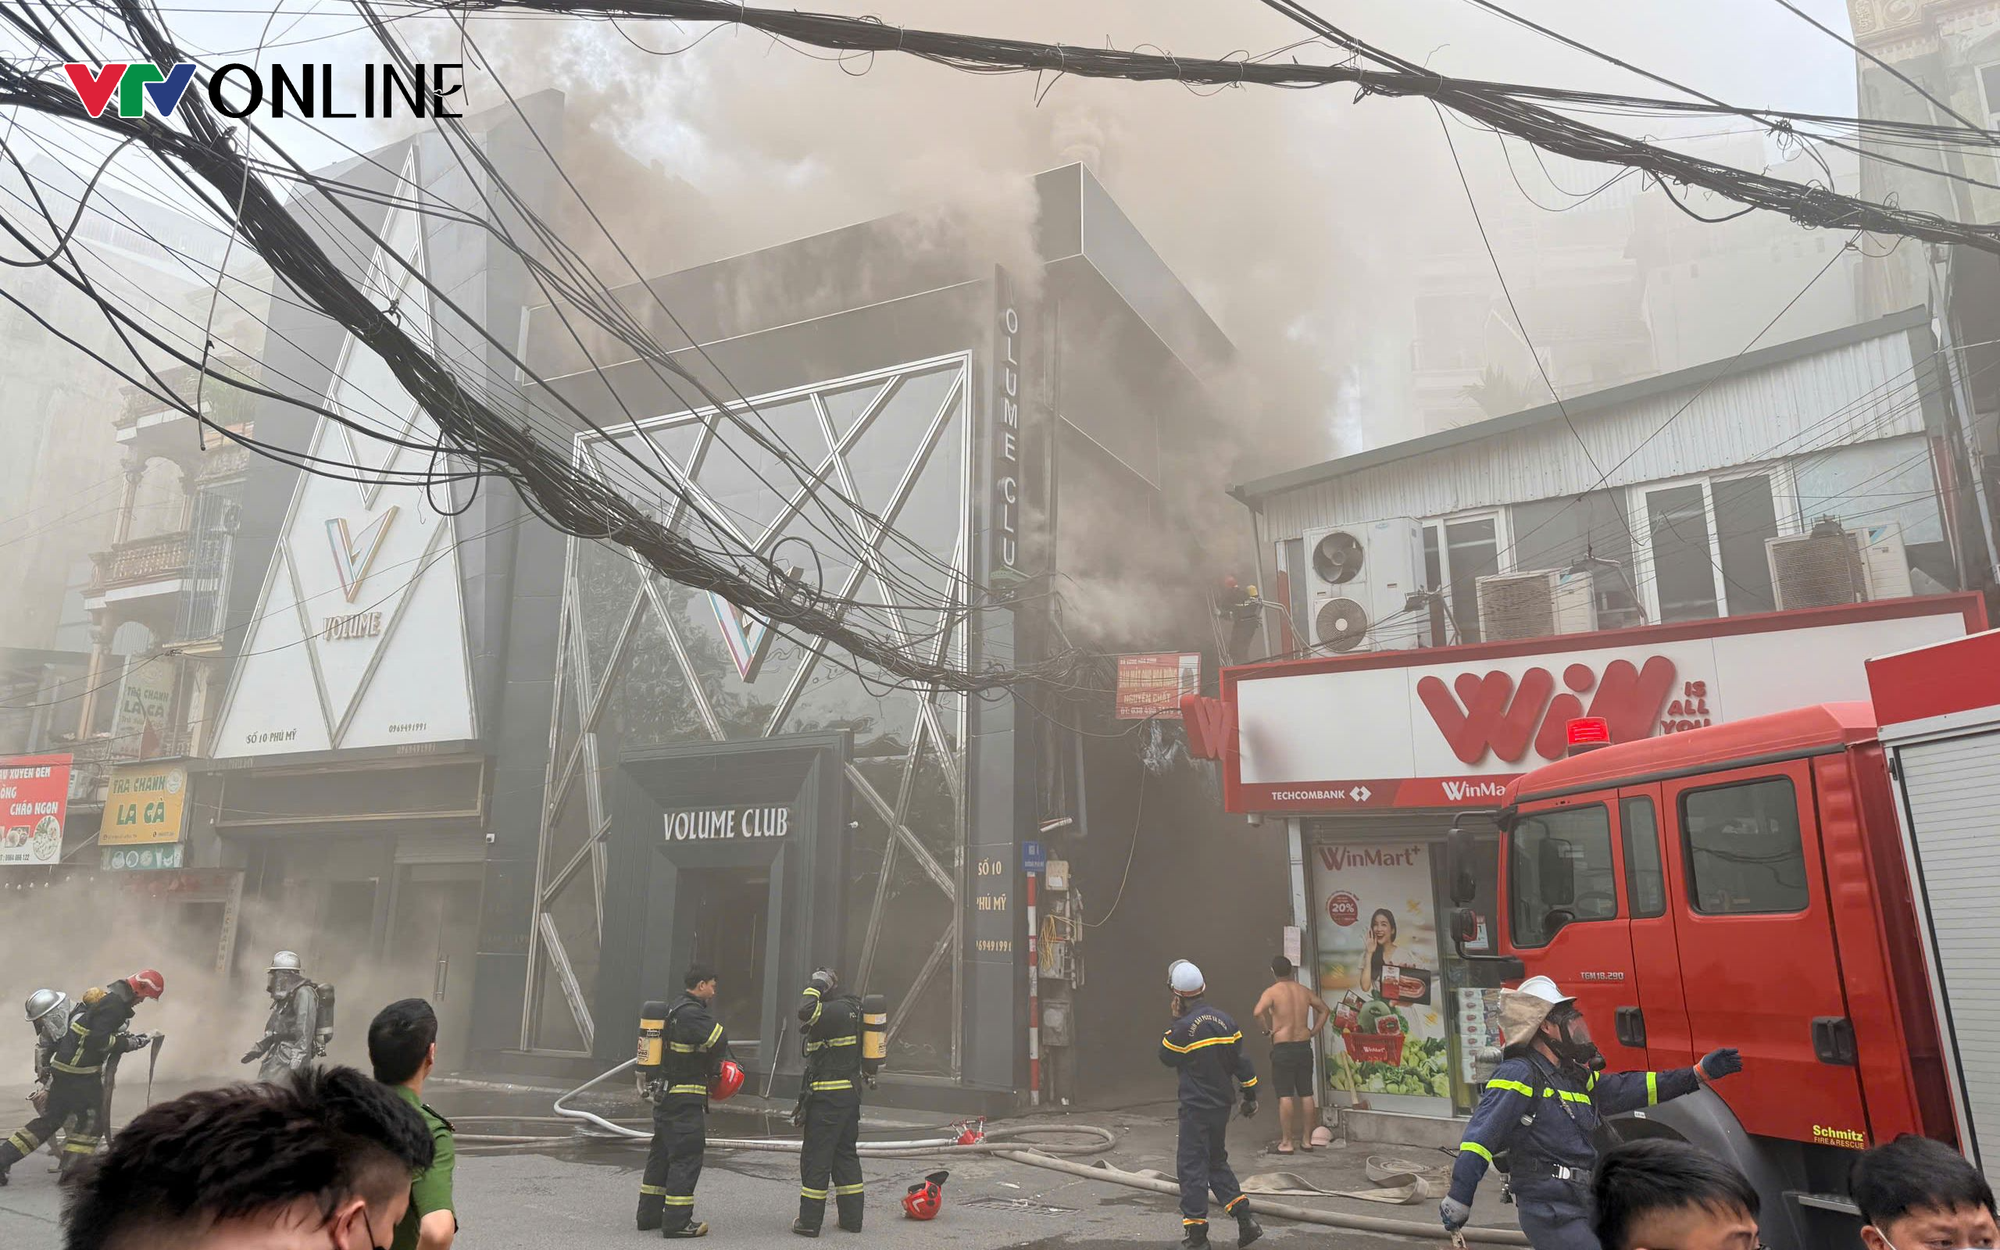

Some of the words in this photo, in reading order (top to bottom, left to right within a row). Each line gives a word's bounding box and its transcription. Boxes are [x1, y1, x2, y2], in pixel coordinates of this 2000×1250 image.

[323, 611, 382, 641] VOLUME
[1684, 681, 1707, 698] IS
[1667, 698, 1710, 716] ALL
[246, 731, 258, 744] SỐ
[259, 734, 268, 743] 10
[1272, 790, 1345, 800] TECHCOMBANK
[34, 801, 59, 815] NGON
[663, 810, 735, 840] VOLUME
[741, 807, 788, 838] CLUB
[978, 857, 990, 876] SỐ
[992, 861, 1002, 875] 10
[1332, 903, 1355, 913] 20%
[1812, 1124, 1864, 1142] Schmitz
